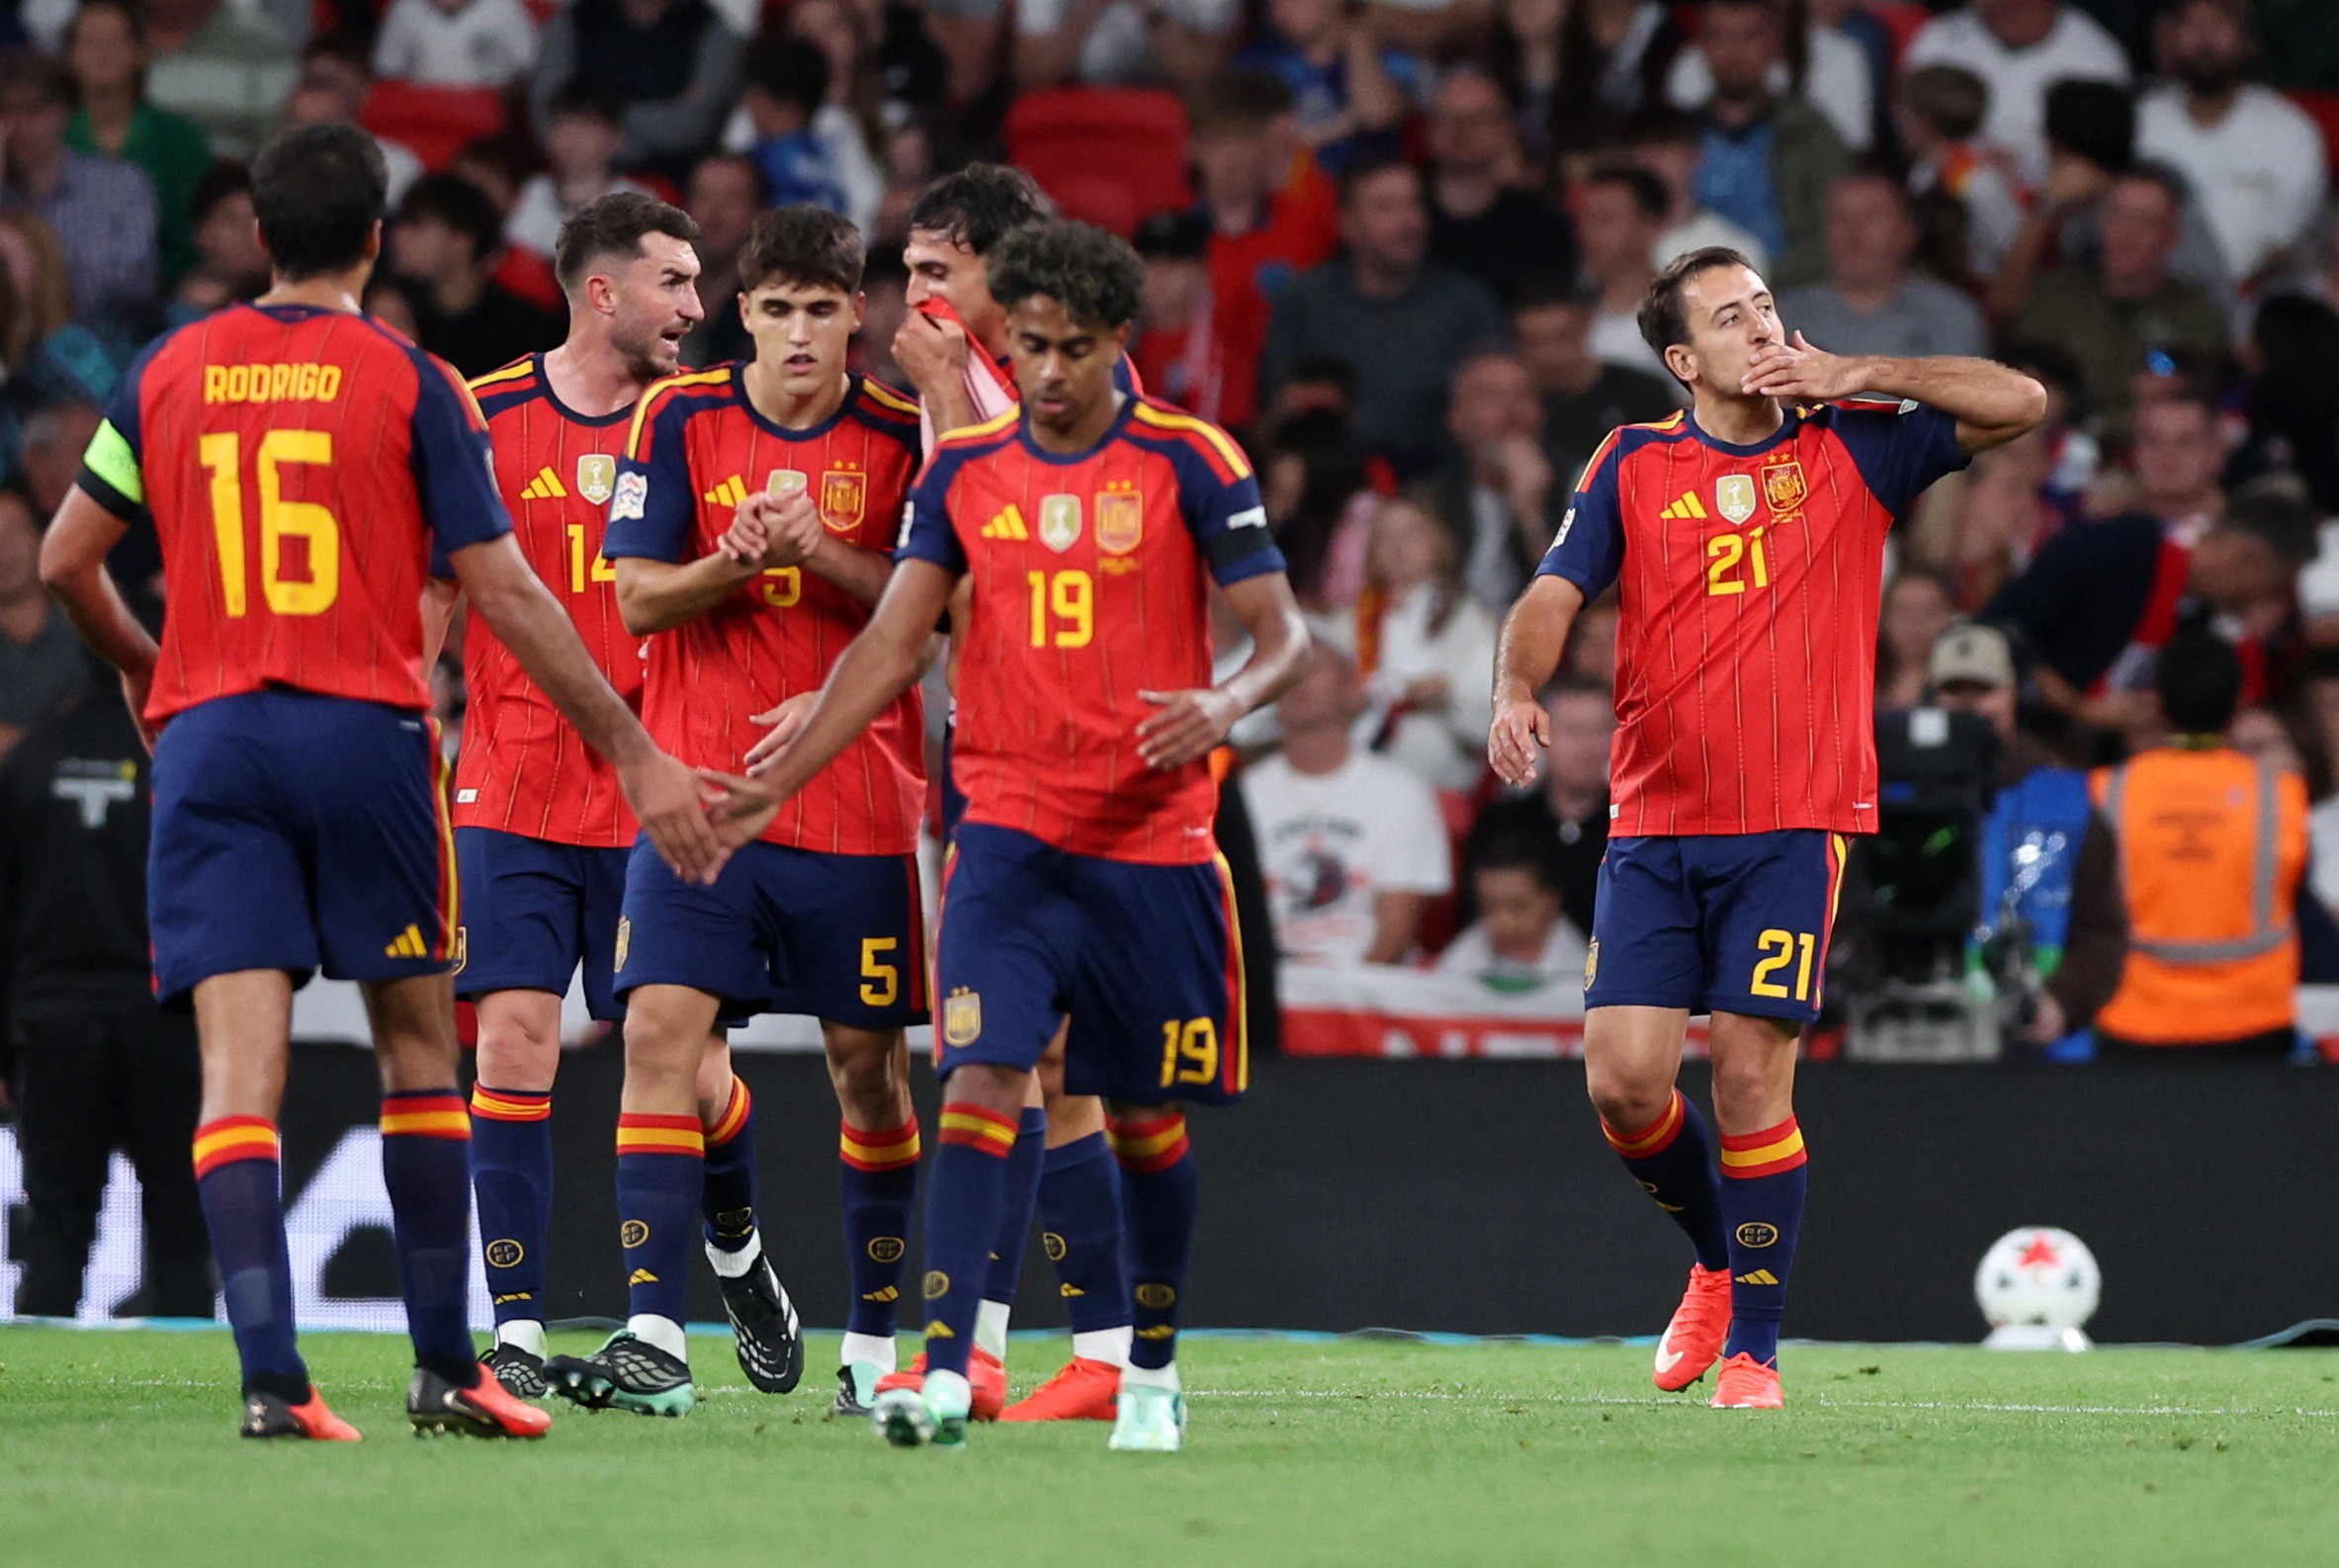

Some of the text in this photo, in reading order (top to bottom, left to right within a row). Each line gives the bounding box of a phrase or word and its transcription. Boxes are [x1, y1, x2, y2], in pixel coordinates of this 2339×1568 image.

[204, 362, 343, 404] RODRIGO
[199, 428, 339, 618] 16
[1707, 525, 1769, 596] 21
[1027, 569, 1093, 649] 19
[859, 937, 897, 1006] 5
[1751, 928, 1815, 1001] 21
[1161, 1016, 1218, 1087] 19
